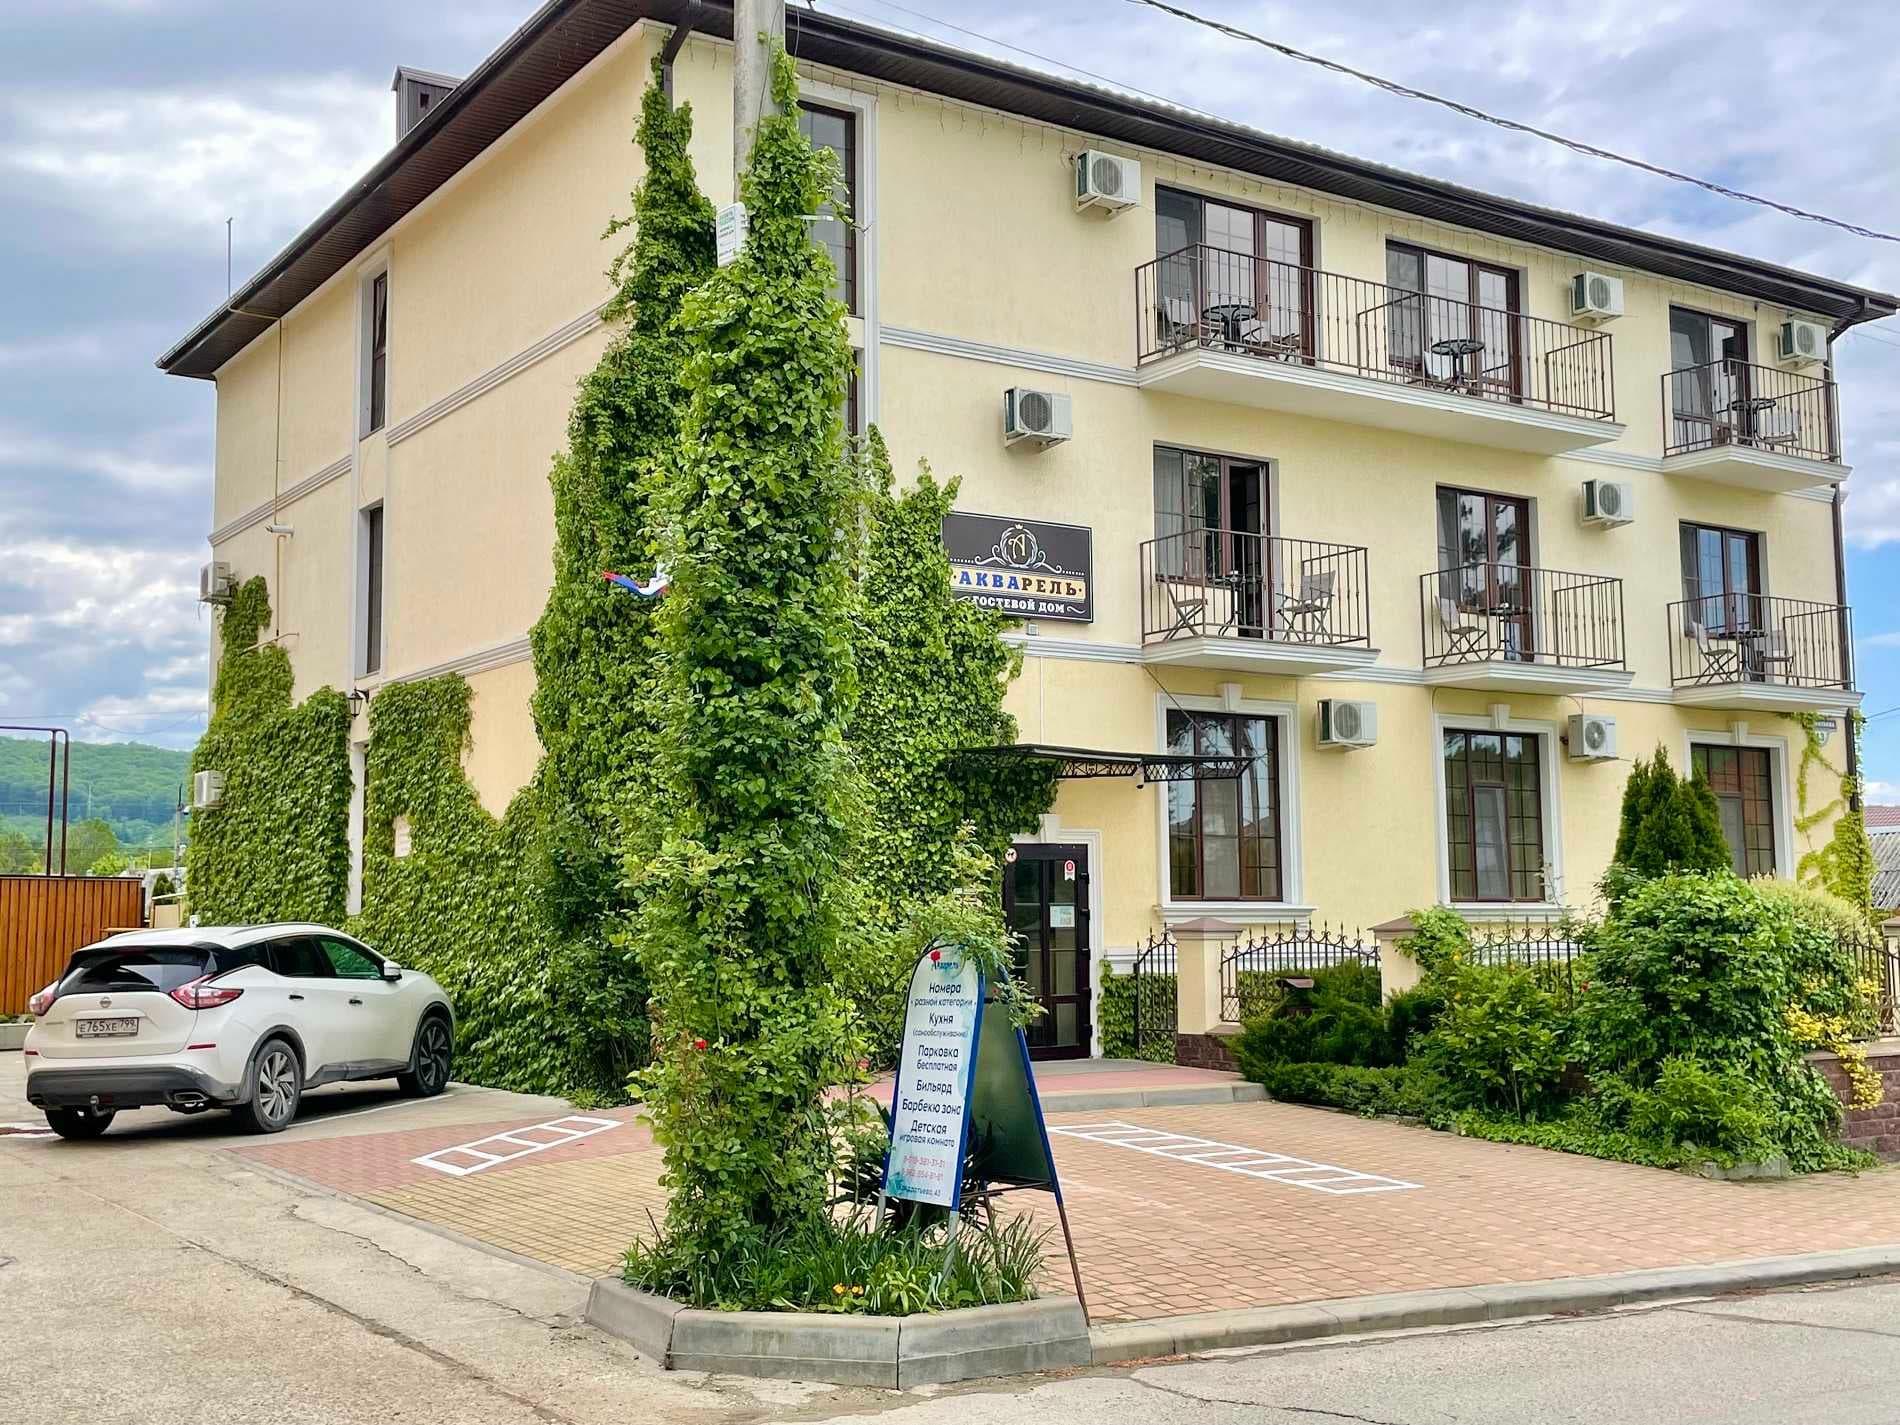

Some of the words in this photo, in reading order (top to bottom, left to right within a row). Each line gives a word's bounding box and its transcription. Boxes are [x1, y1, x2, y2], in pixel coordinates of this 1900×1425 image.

[959, 571, 1077, 596] АКВАРЕЛЬ
[1038, 601, 1065, 613] ДОМ
[929, 982, 961, 995] Номера
[914, 998, 938, 1008] разной
[80, 1021, 118, 1033] Е765ХЕ
[120, 1019, 135, 1029] 799
[929, 1012, 954, 1026] Кухня
[918, 1044, 959, 1058] Парковка
[916, 1059, 958, 1071] бесплатная
[916, 1079, 952, 1095] Бильярд
[902, 1098, 941, 1113] Барбекю
[941, 1104, 962, 1115] зона
[910, 1119, 947, 1134] Детская
[900, 1134, 926, 1144] игровая
[927, 1137, 955, 1147] комната
